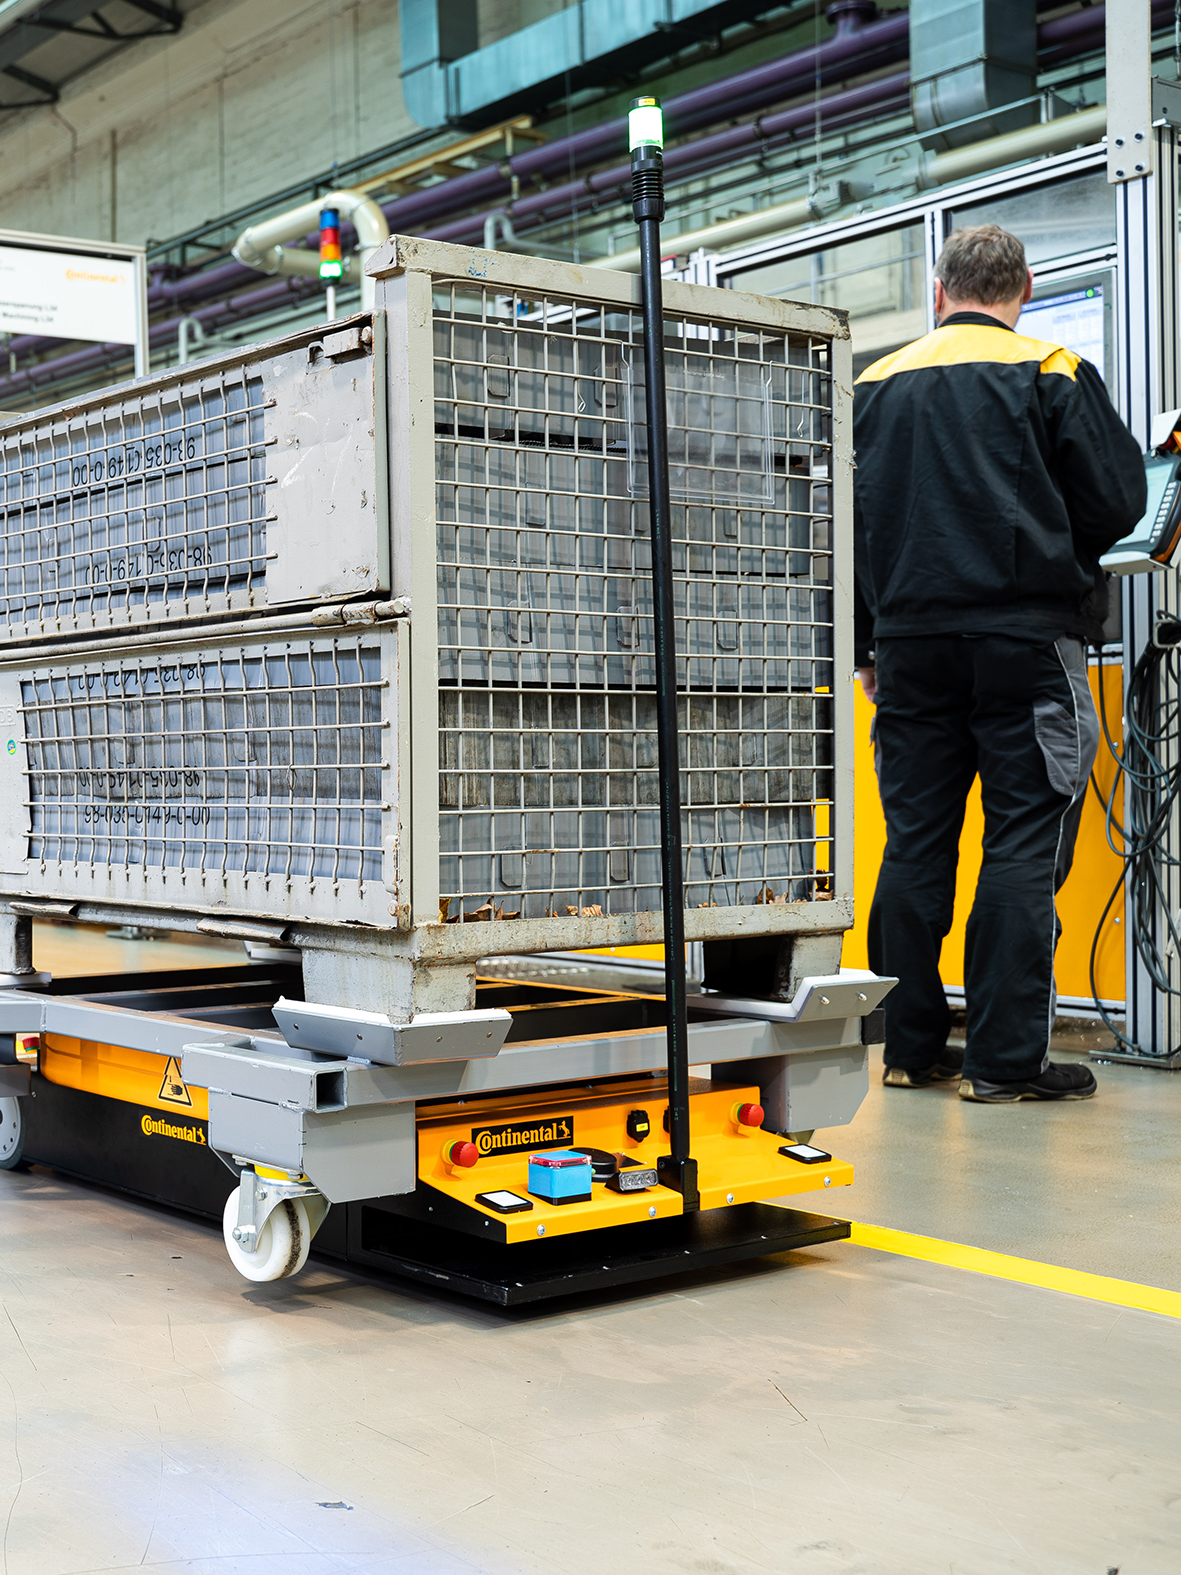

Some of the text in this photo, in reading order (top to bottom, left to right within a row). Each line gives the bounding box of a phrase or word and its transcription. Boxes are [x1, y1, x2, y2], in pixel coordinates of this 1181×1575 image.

[66, 269, 118, 284] Continental
[141, 1114, 197, 1143] Continental
[475, 1122, 558, 1155] Continental
